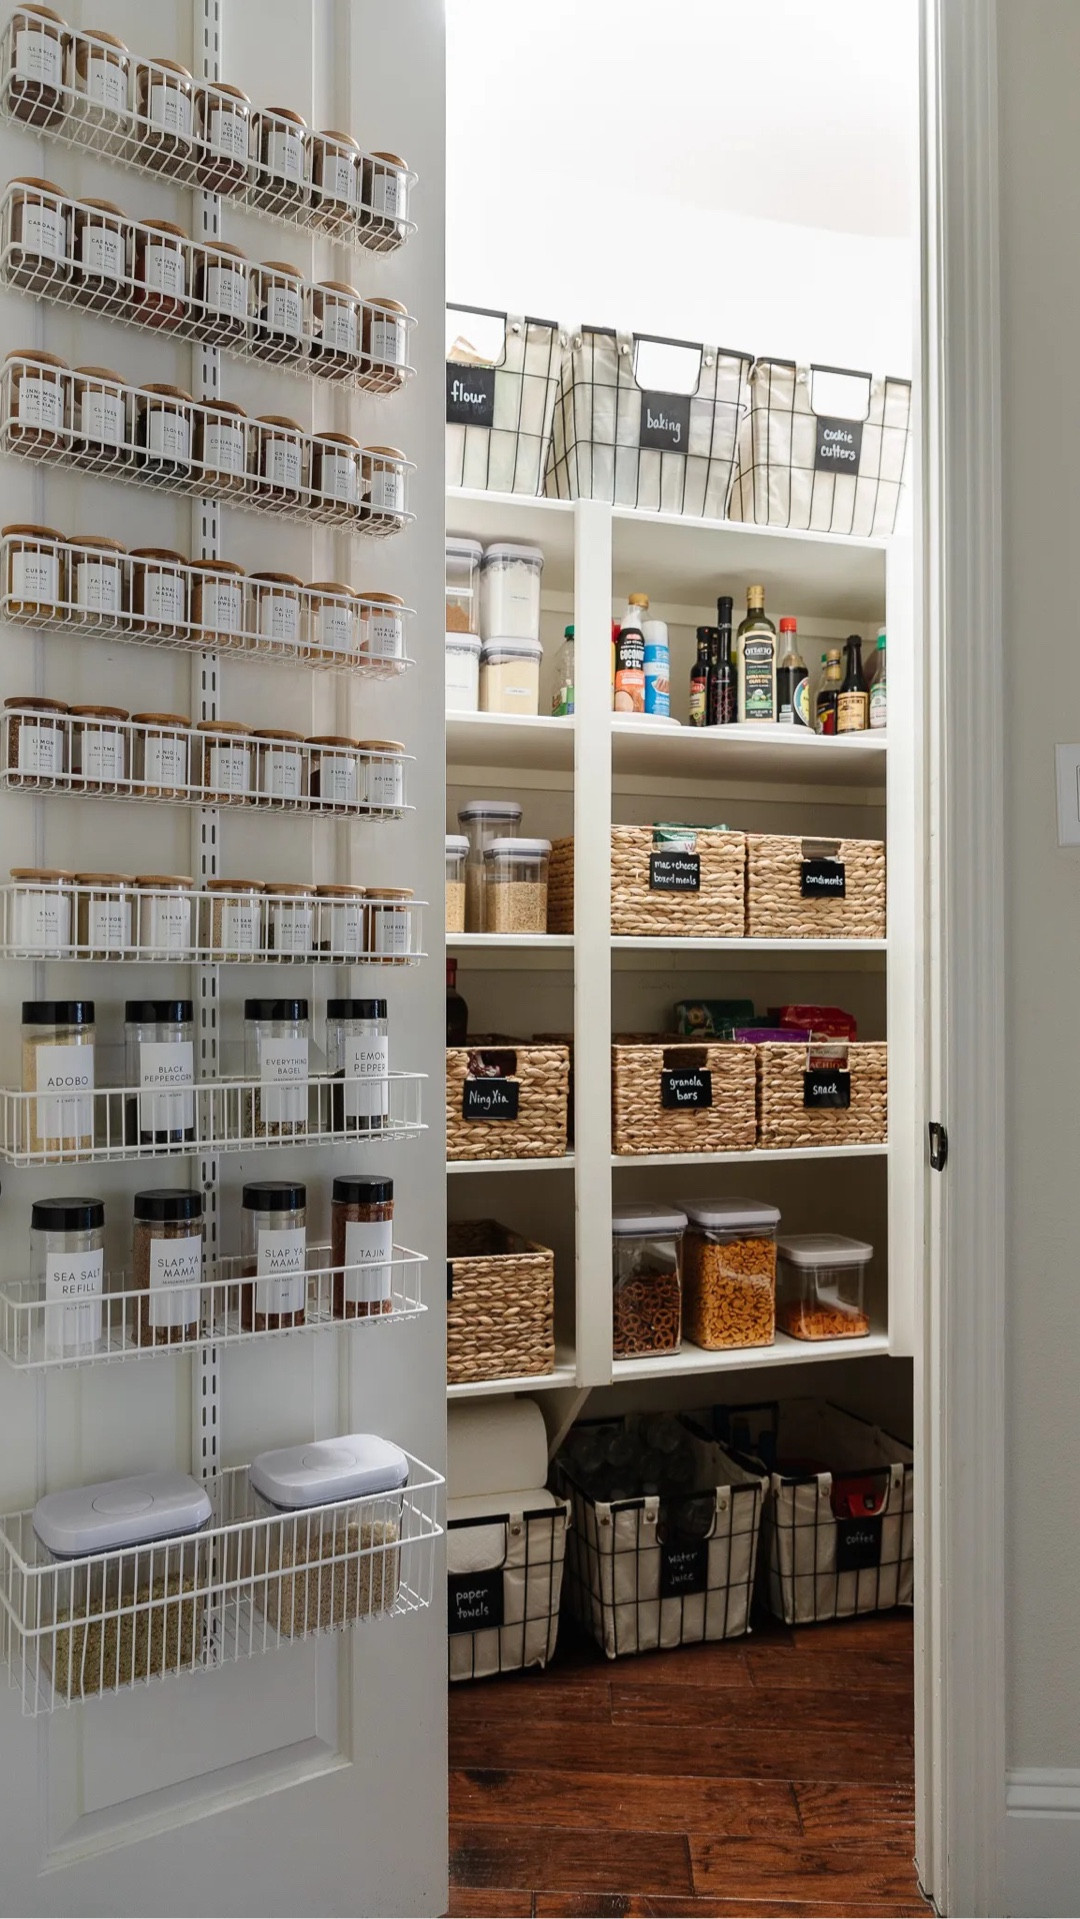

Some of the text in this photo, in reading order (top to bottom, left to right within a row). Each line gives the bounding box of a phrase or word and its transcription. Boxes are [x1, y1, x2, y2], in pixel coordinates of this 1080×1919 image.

[450, 380, 487, 404] flour
[646, 408, 682, 444] baking
[823, 429, 854, 444] cookie
[820, 444, 856, 461] cutters
[274, 606, 294, 614] GALIC
[625, 660, 642, 668] OIL
[805, 875, 843, 887] condiments
[265, 1058, 307, 1066] EVERYTHING
[355, 1052, 386, 1061] LEMON
[158, 1065, 184, 1074] BLACK
[277, 1067, 301, 1075] BAGEL
[353, 1063, 386, 1072] PEPPER
[47, 1076, 89, 1087] ADOBO
[144, 1073, 192, 1082] PEPPERCORN
[669, 1075, 703, 1090] granola
[676, 1089, 698, 1101] bars
[812, 1082, 838, 1096] snack
[264, 1248, 304, 1258] SLAP YA
[360, 1249, 385, 1258] TAJIN
[157, 1255, 199, 1267] SLAP YA
[270, 1257, 299, 1267] MAMA
[53, 1267, 101, 1282] SEA SALT
[163, 1266, 195, 1278] MAMA
[62, 1282, 95, 1294] REFILL
[845, 1531, 875, 1545] coffee
[456, 1588, 489, 1606] paper
[456, 1602, 490, 1620] towels
